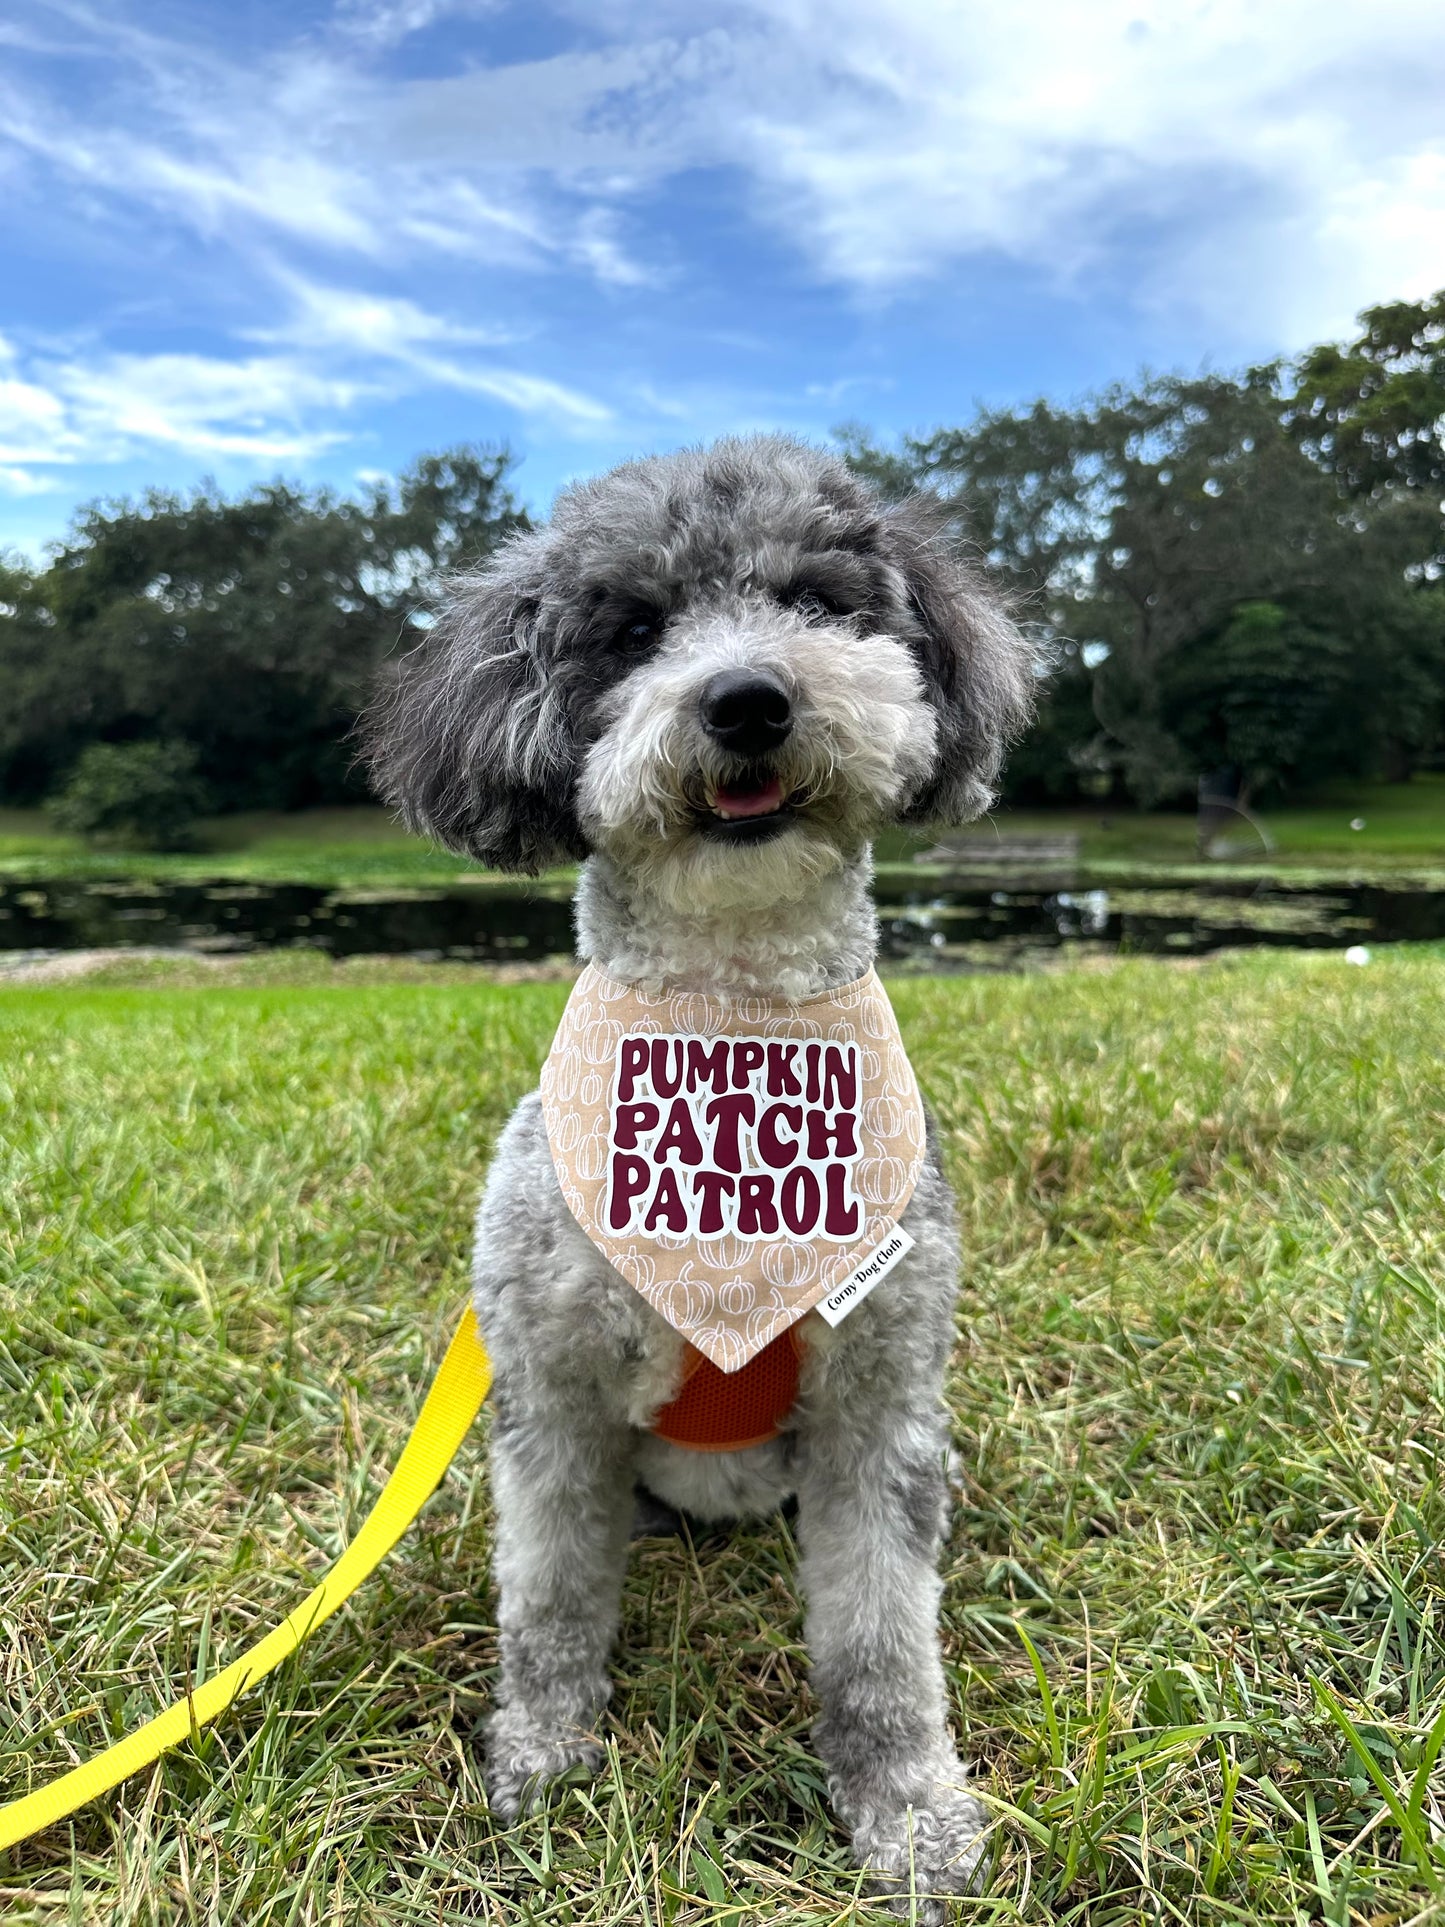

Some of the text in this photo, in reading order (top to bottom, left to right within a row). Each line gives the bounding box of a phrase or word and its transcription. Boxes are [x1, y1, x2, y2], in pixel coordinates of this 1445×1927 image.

[618, 1038, 856, 1110] PUMPKIN
[613, 1093, 857, 1174] PATCH
[609, 1151, 859, 1235] PATROL
[827, 1238, 902, 1311] Corny Dog Cloth
